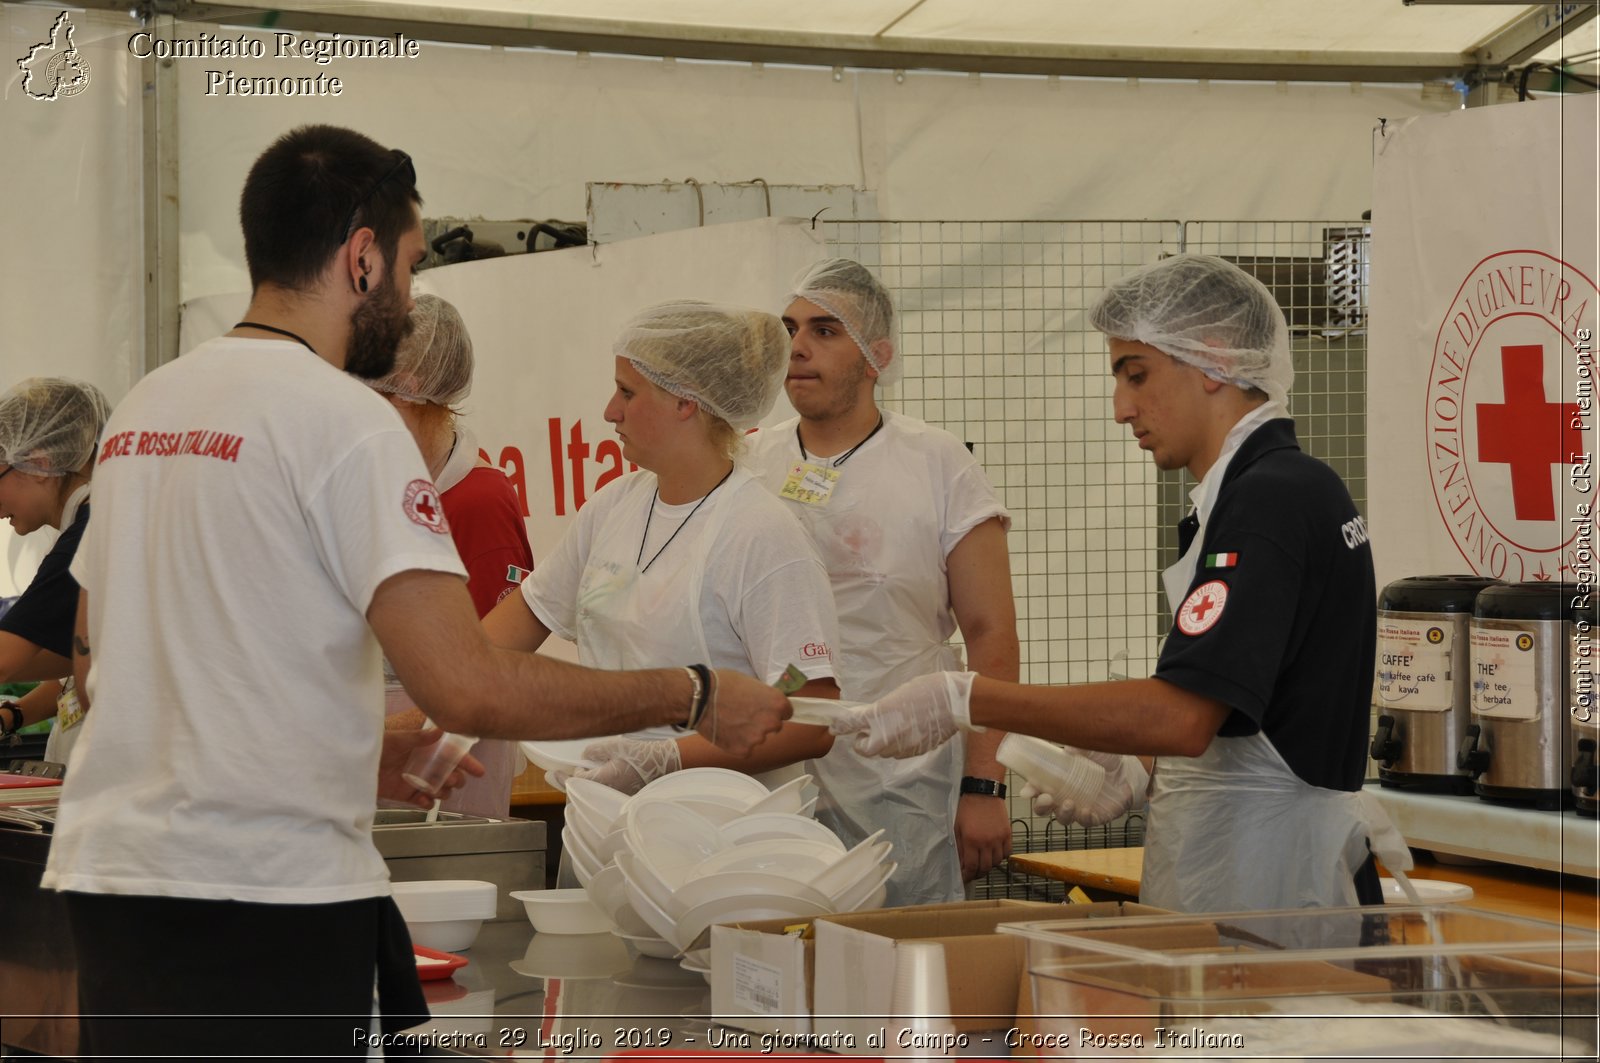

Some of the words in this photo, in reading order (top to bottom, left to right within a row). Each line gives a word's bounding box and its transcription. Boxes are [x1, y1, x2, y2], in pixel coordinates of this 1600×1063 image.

[1453, 298, 1480, 348] DI
[1476, 266, 1589, 337] GINEVRA
[135, 431, 183, 457] ROSSA
[181, 430, 244, 463] ITALIANA
[548, 417, 639, 516] Ita
[1382, 654, 1413, 667] CAFFE'
[1478, 663, 1498, 675] THE'
[1417, 673, 1436, 682] cafè
[1399, 685, 1419, 694] kawa
[1494, 682, 1507, 691] tee
[1483, 694, 1512, 704] herbata
